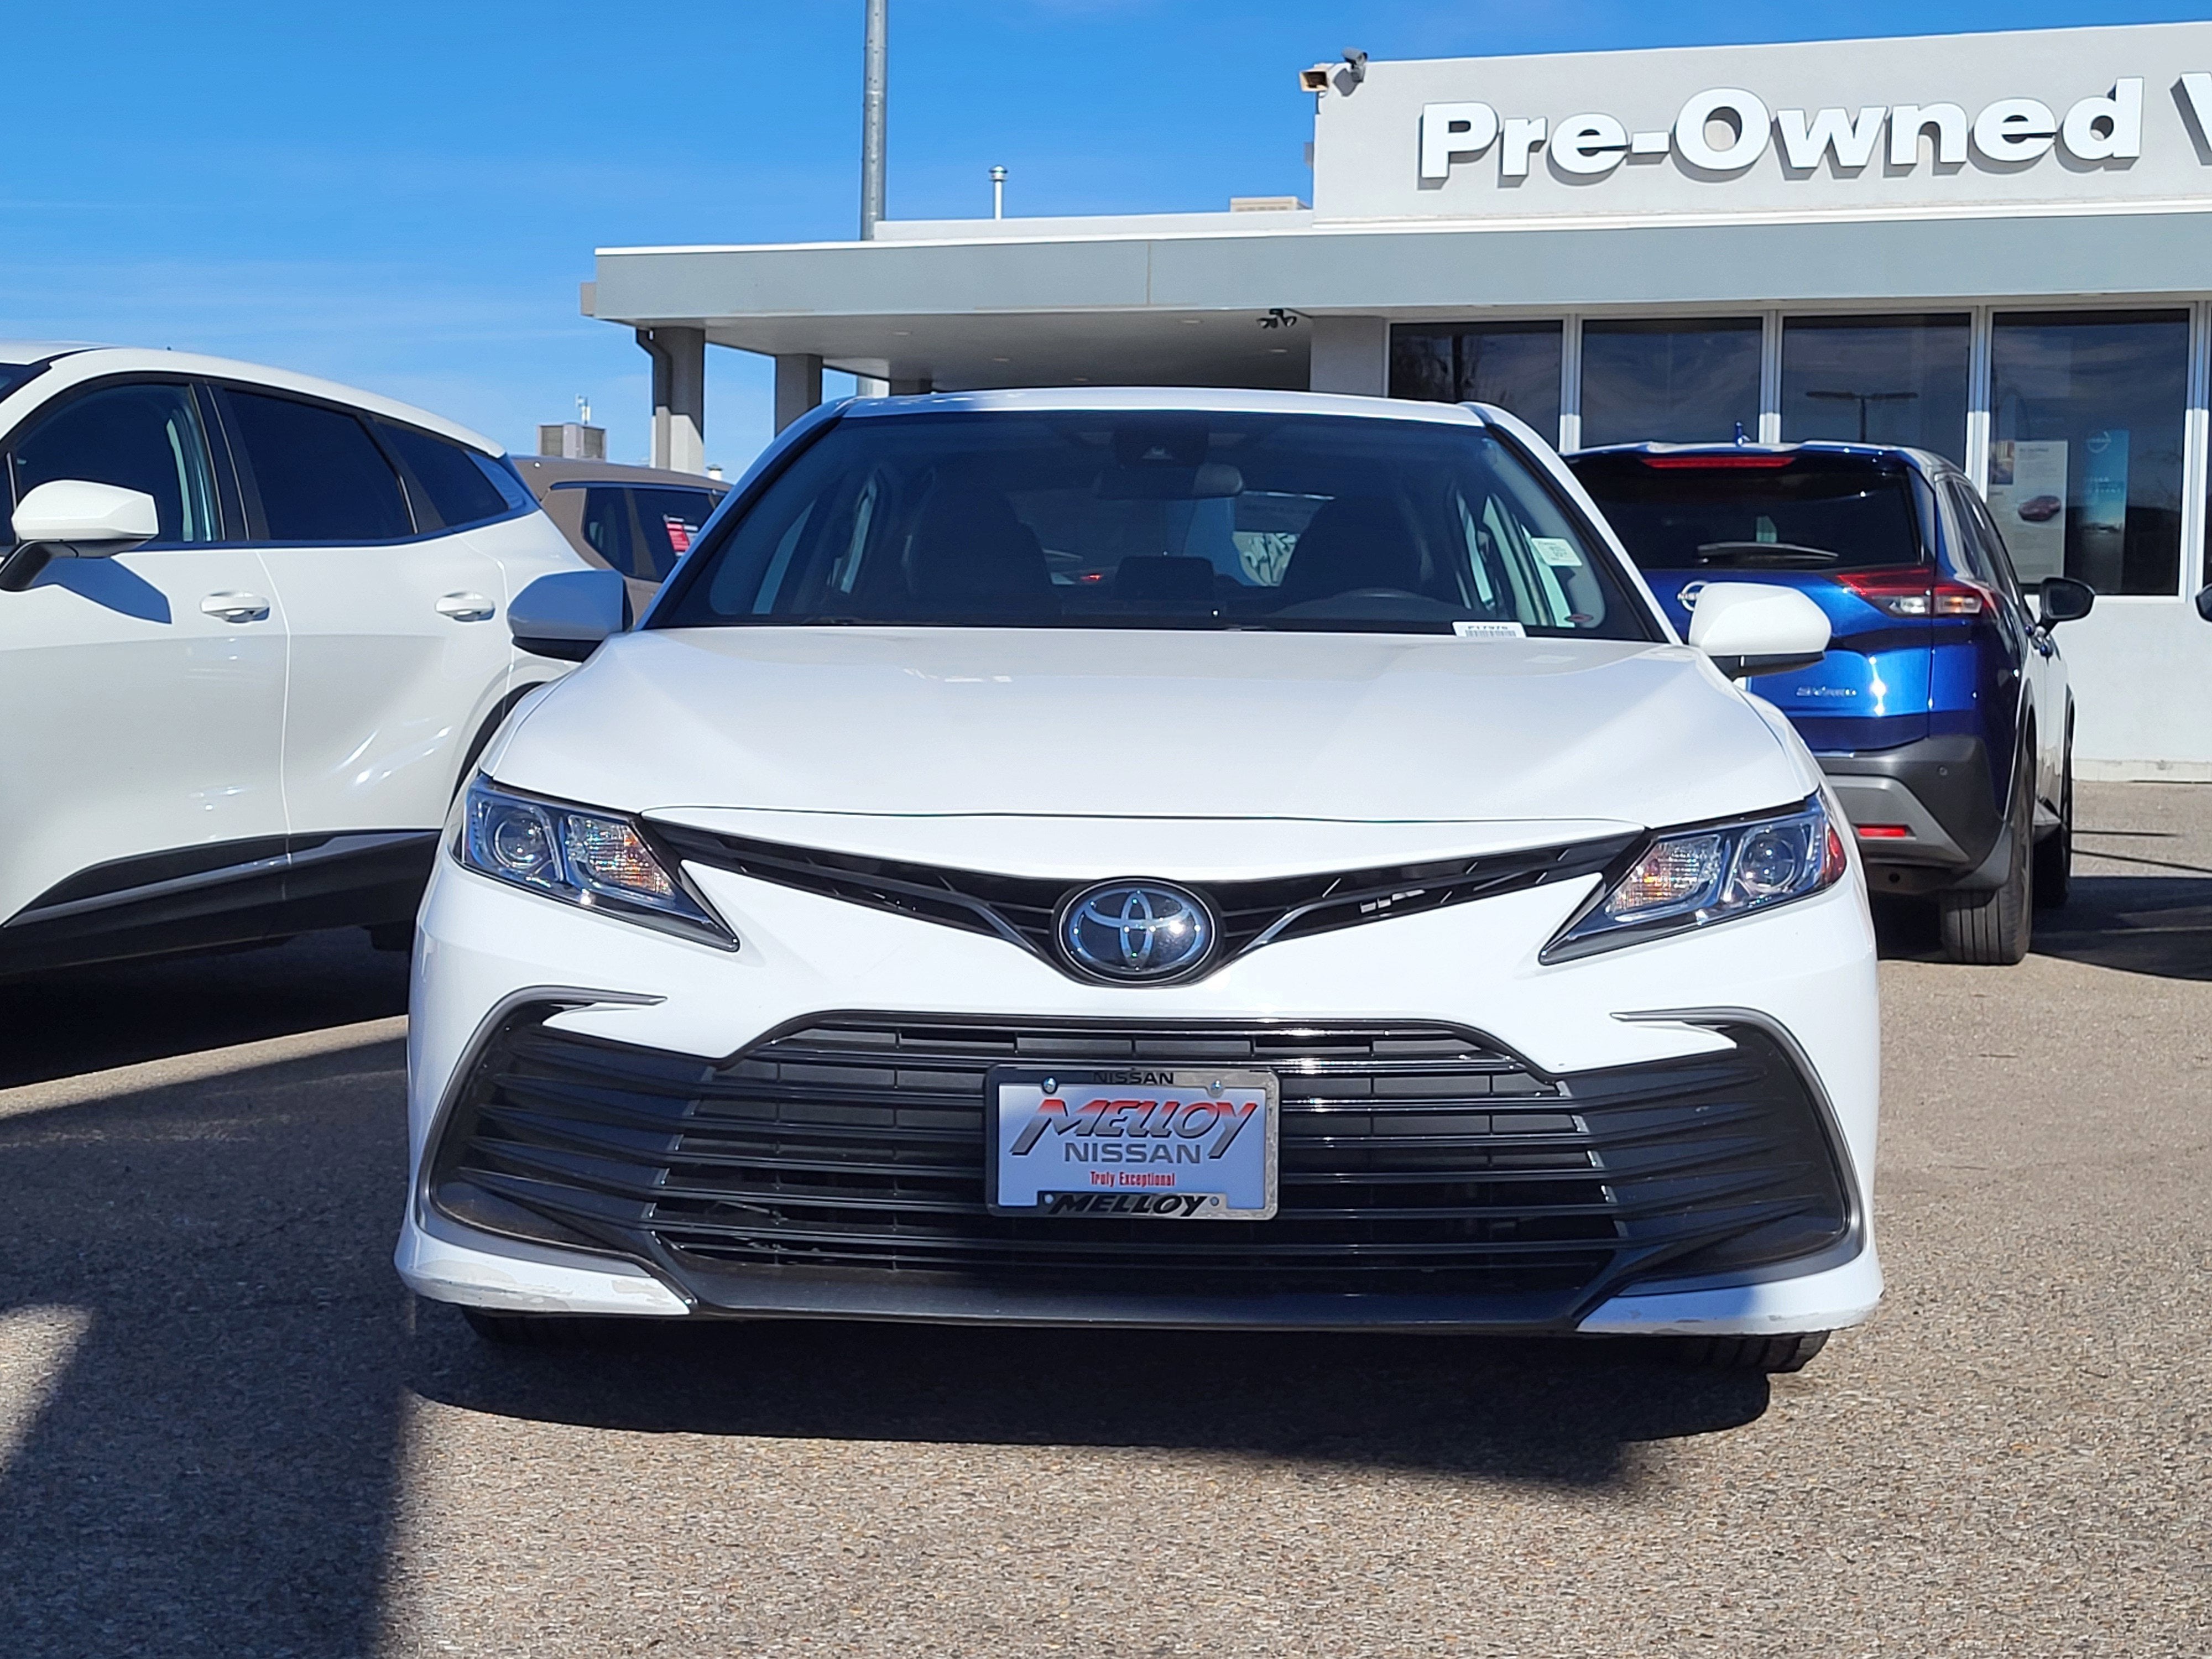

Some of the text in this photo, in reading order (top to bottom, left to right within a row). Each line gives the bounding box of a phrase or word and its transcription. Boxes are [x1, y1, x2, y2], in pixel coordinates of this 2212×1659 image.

[1419, 76, 2143, 182] Pre-Owned
[1094, 1072, 1174, 1084] NISSAN
[1009, 1098, 1258, 1159] MELLOY
[1065, 1142, 1201, 1164] NISSAN
[1090, 1171, 1175, 1187] Truly Exceptional
[1052, 1194, 1207, 1217] MELLOY
